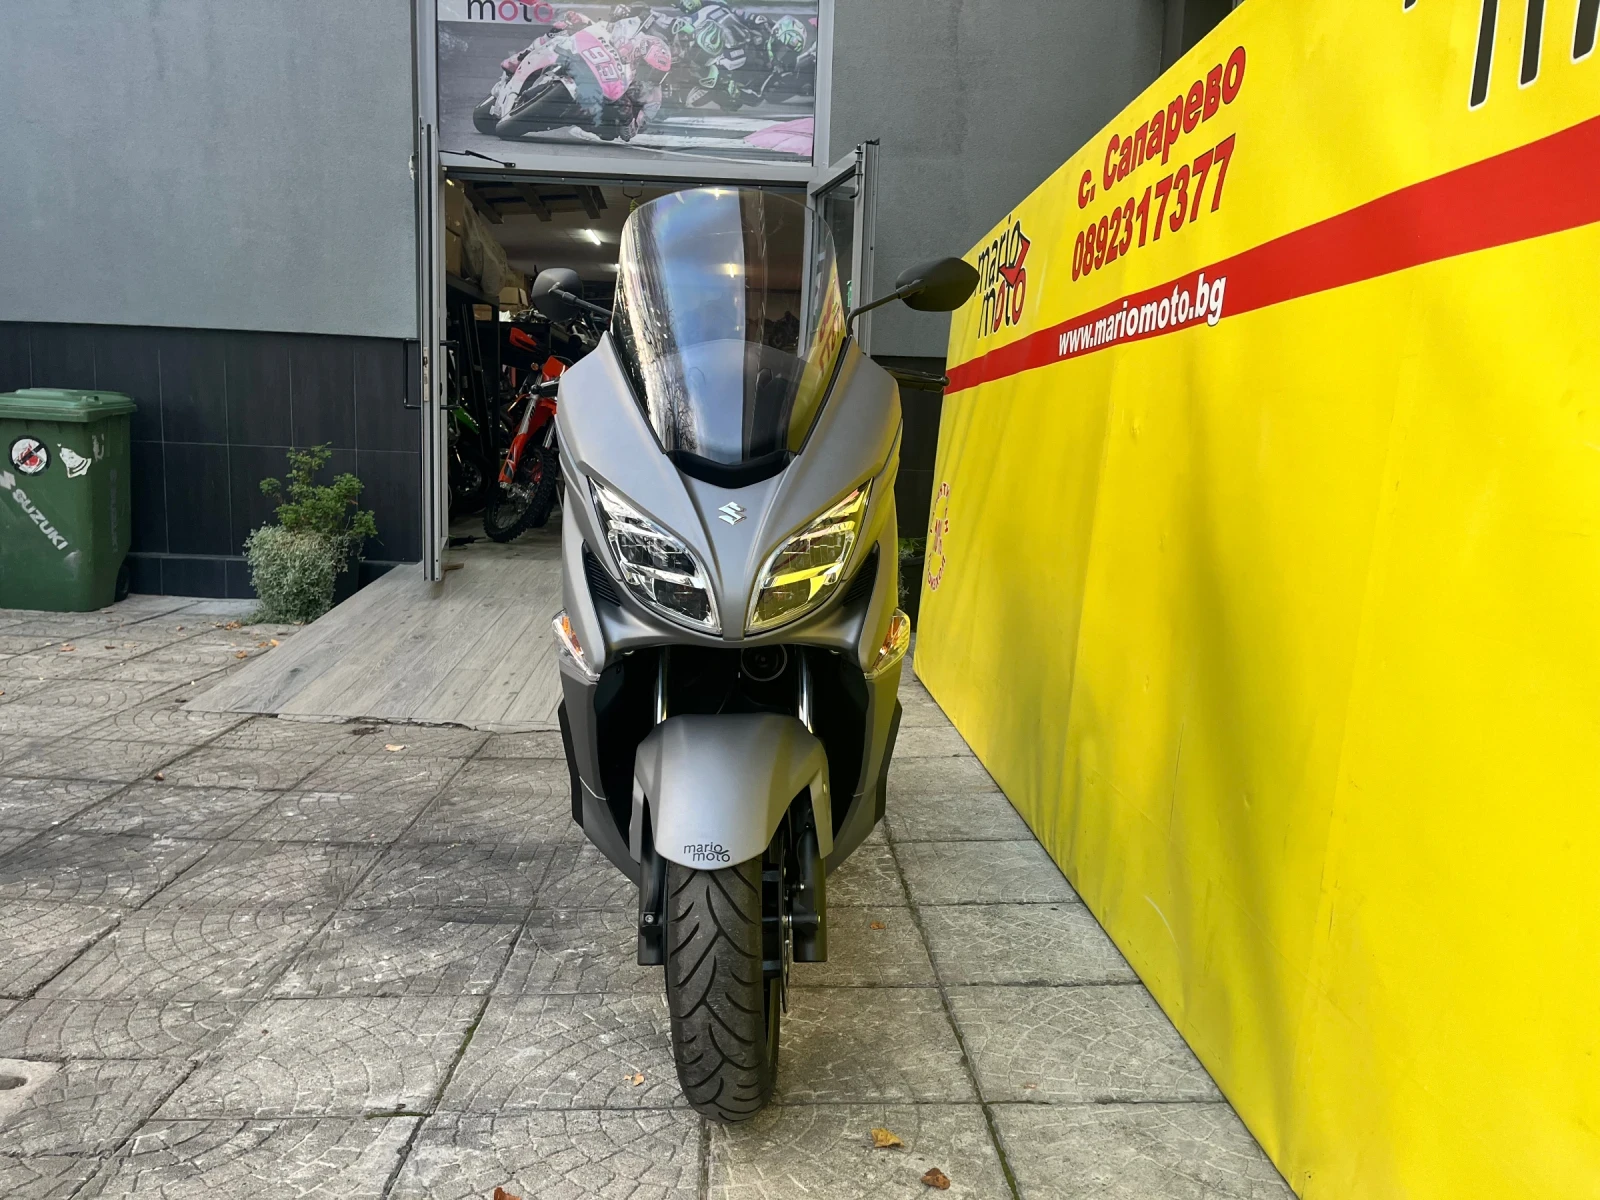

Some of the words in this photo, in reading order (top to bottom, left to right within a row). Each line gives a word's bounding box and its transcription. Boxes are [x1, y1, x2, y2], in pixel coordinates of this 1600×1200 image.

[467, 0, 554, 23] moto
[1102, 45, 1246, 191] Сапарево
[1071, 132, 1236, 282] 0892317377
[974, 213, 1020, 297] mario
[978, 267, 1026, 339] moto
[1058, 271, 1227, 357] www.mariomoto.bg
[12, 488, 69, 551] SUZUKI
[683, 841, 723, 854] mario
[692, 852, 731, 863] moto
